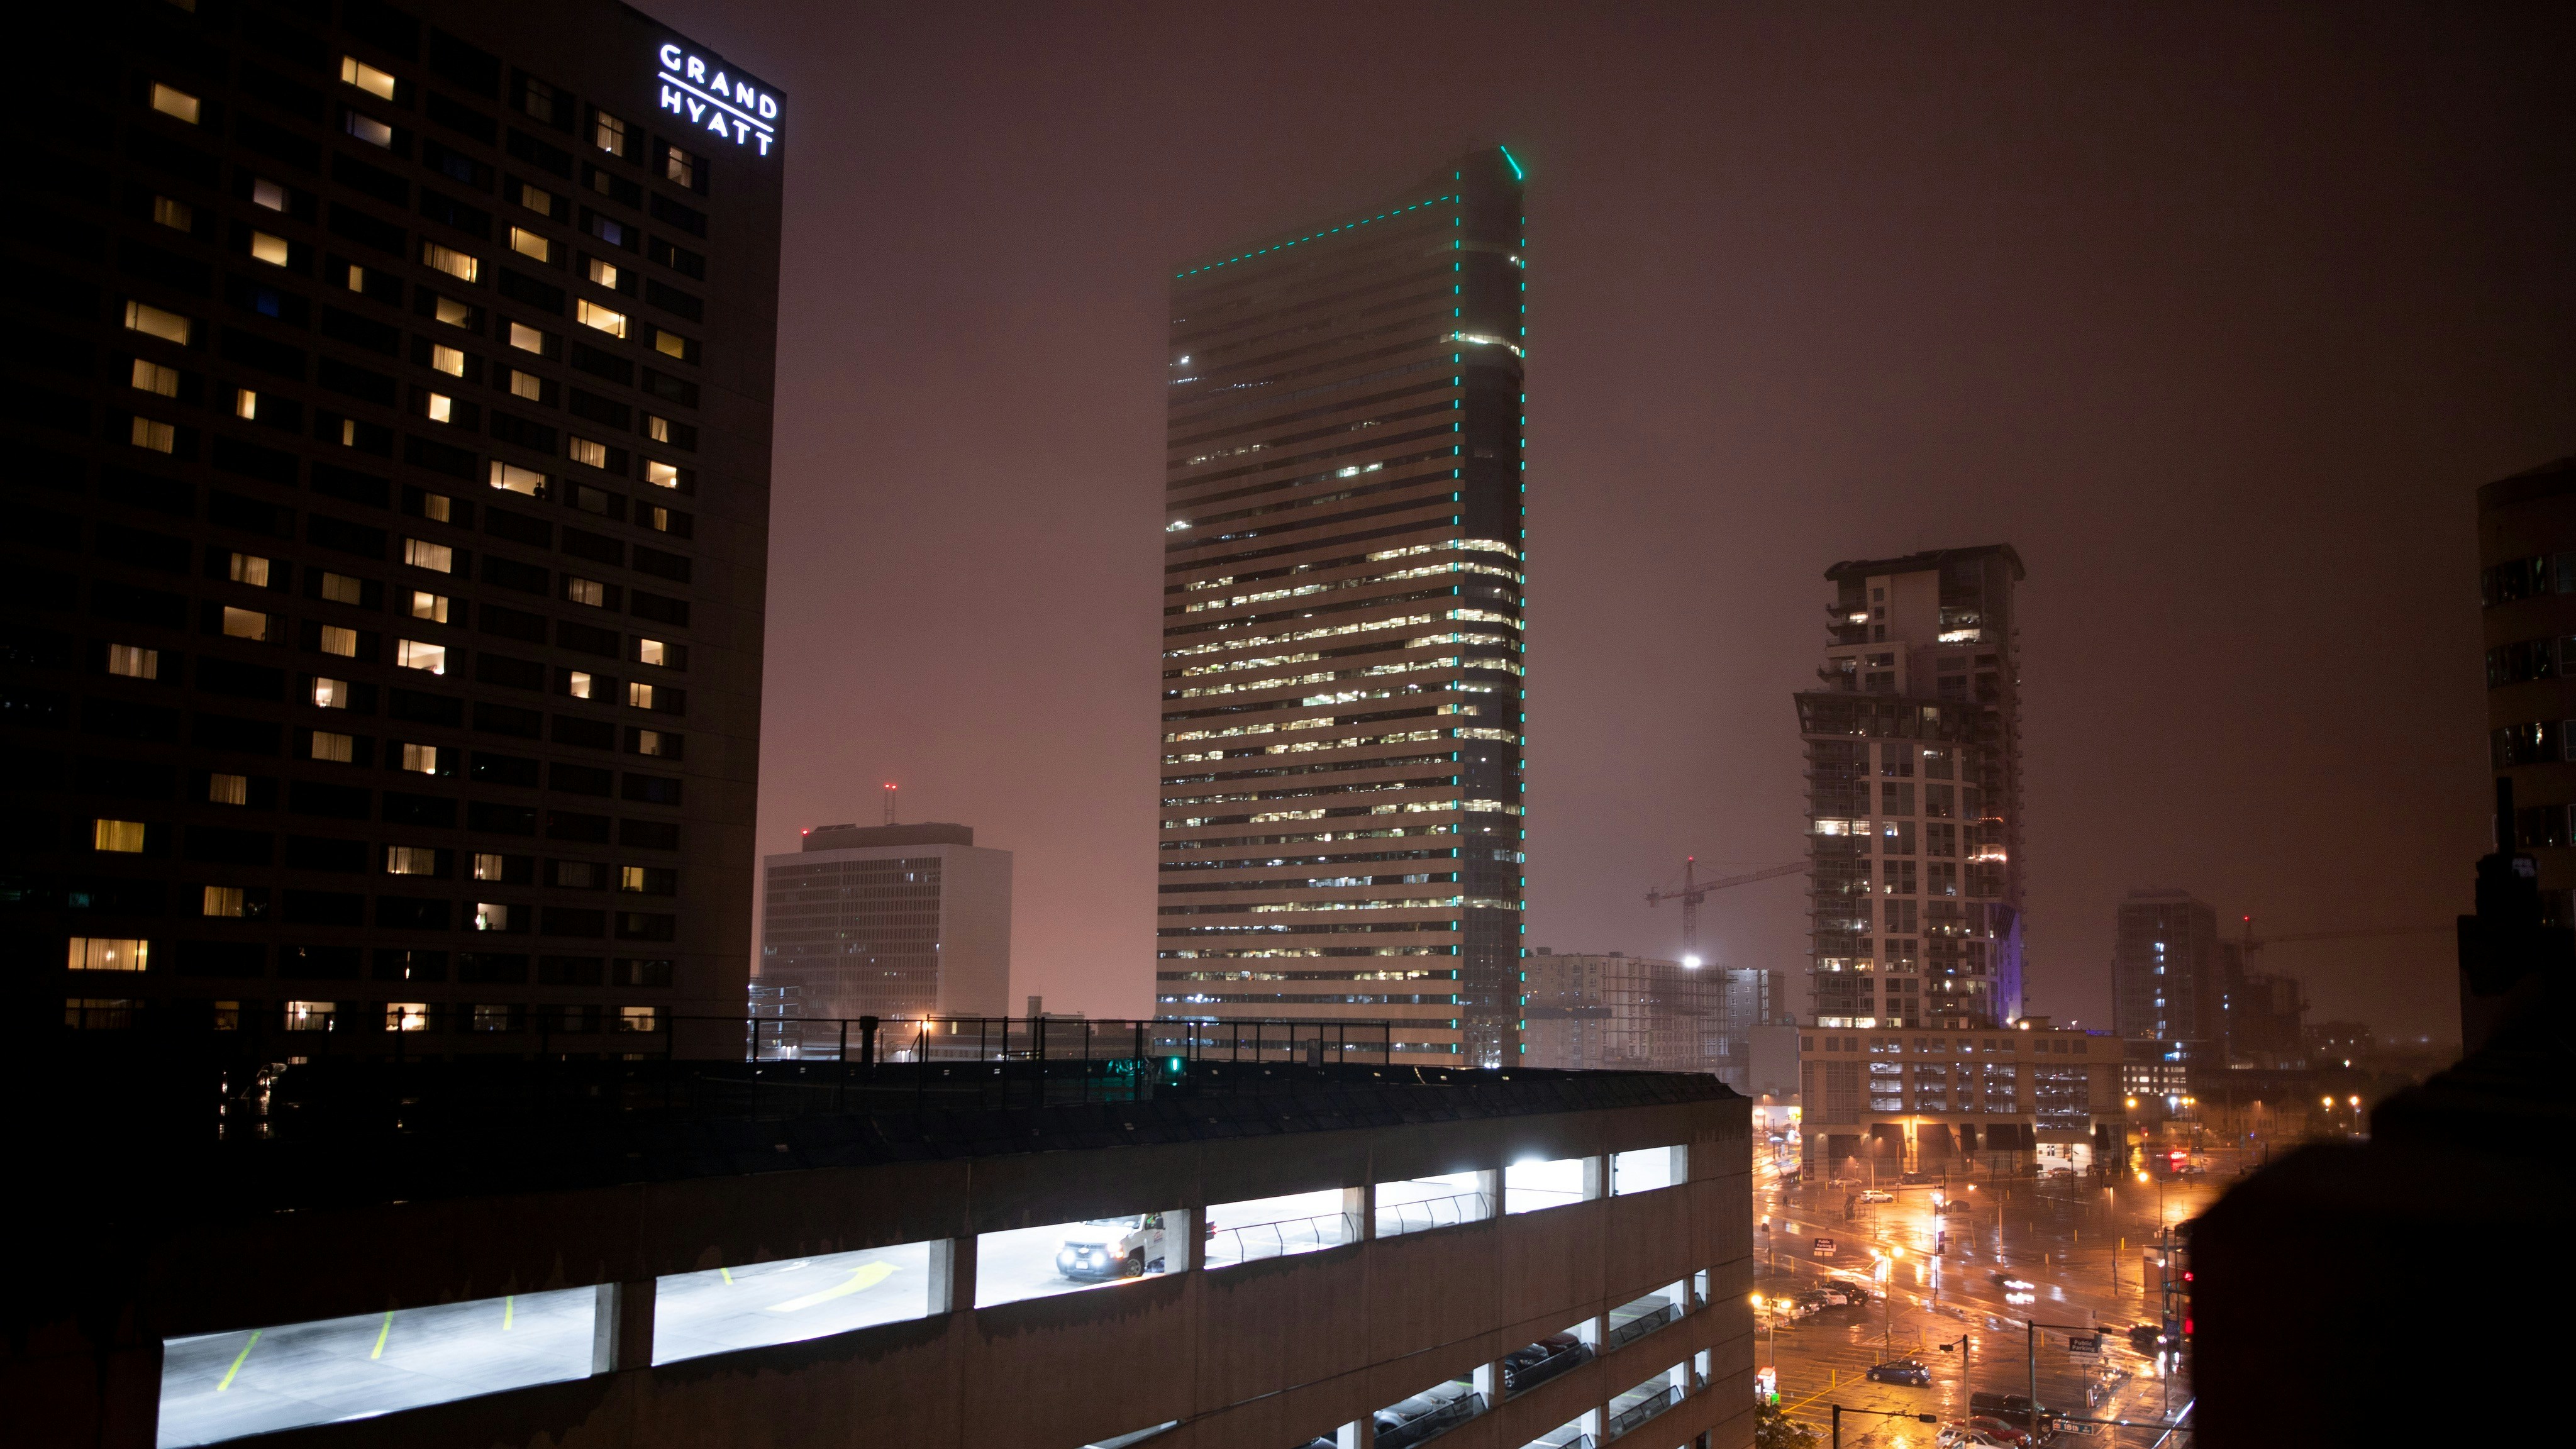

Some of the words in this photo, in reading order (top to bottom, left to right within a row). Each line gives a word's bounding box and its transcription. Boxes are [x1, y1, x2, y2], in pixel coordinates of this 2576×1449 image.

[660, 44, 777, 118] GRAND
[661, 86, 773, 155] HYATT
[2072, 1345, 2095, 1353] Parking
